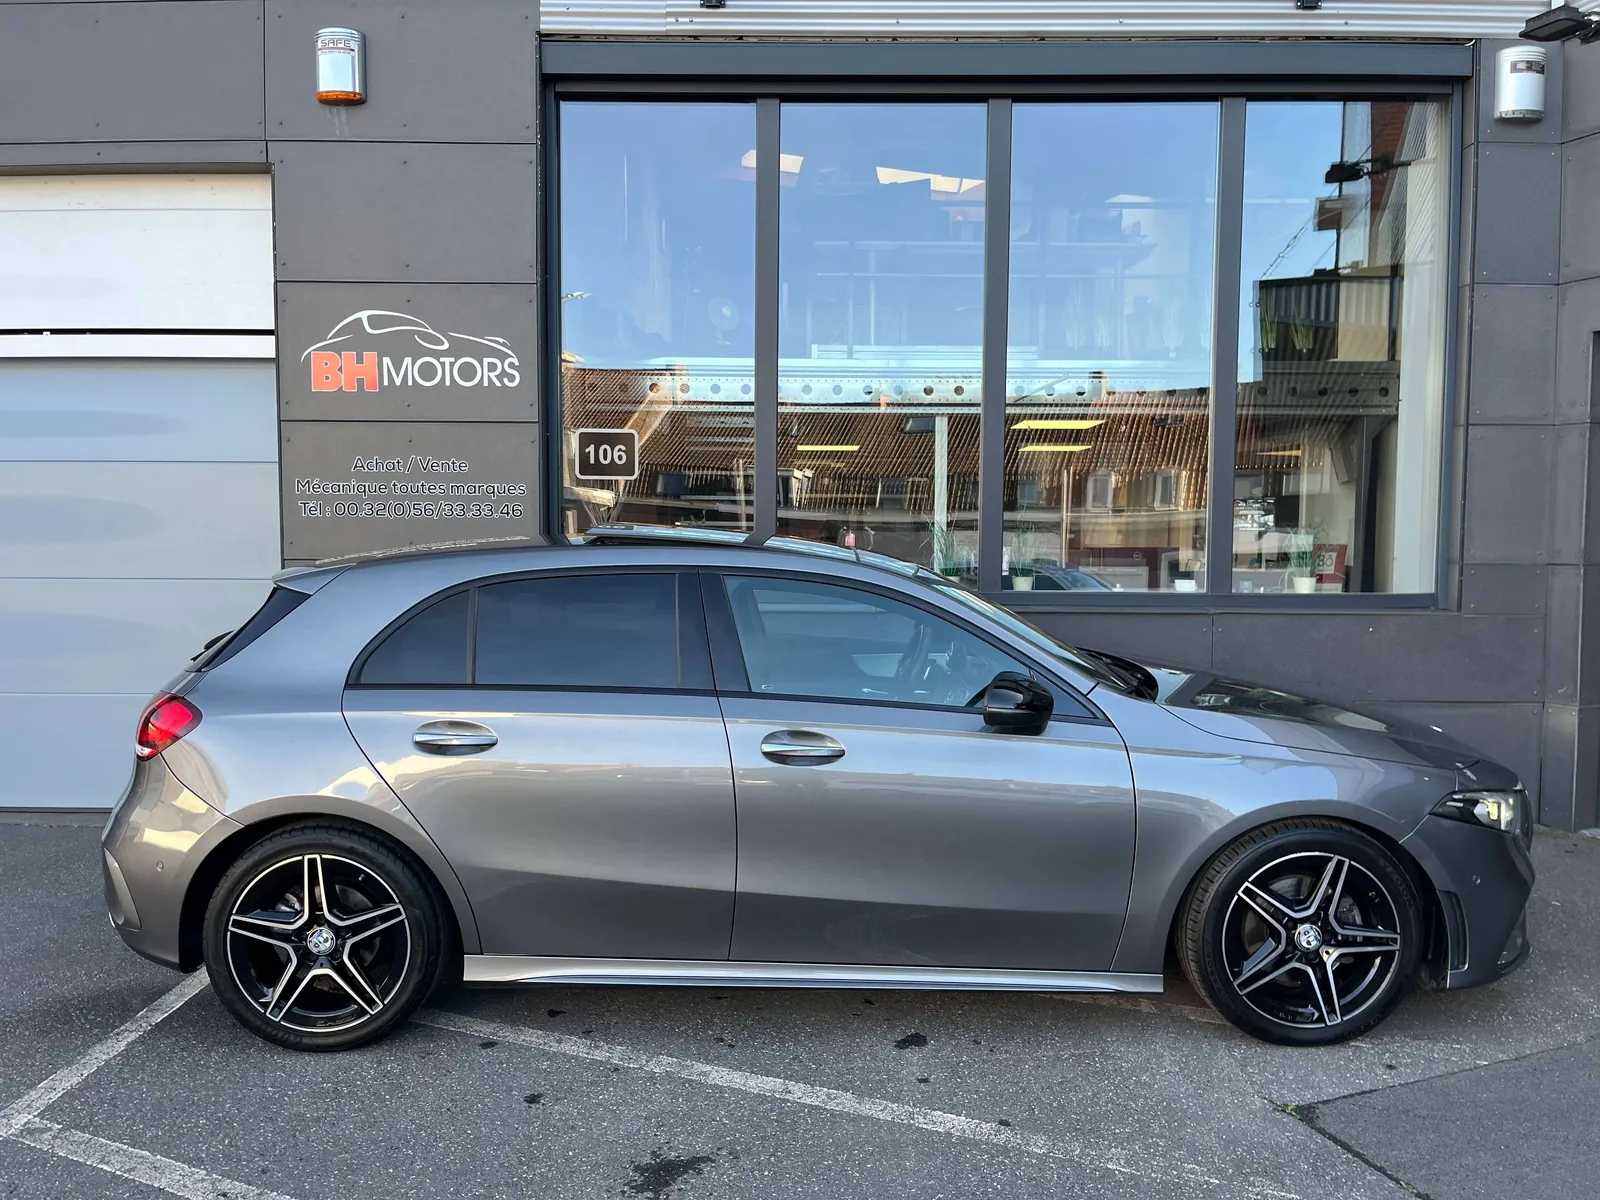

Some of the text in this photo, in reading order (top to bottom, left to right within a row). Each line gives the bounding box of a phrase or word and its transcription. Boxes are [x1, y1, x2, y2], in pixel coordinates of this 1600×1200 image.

[320, 39, 352, 48] SAFE
[311, 351, 521, 392] BH MOTORS
[352, 456, 403, 472] Achat
[417, 457, 469, 472] Vente
[585, 444, 627, 465] 106
[295, 478, 527, 499] Mécanique toutes marques
[334, 502, 523, 519] 00.32(0)56/33.33.46
